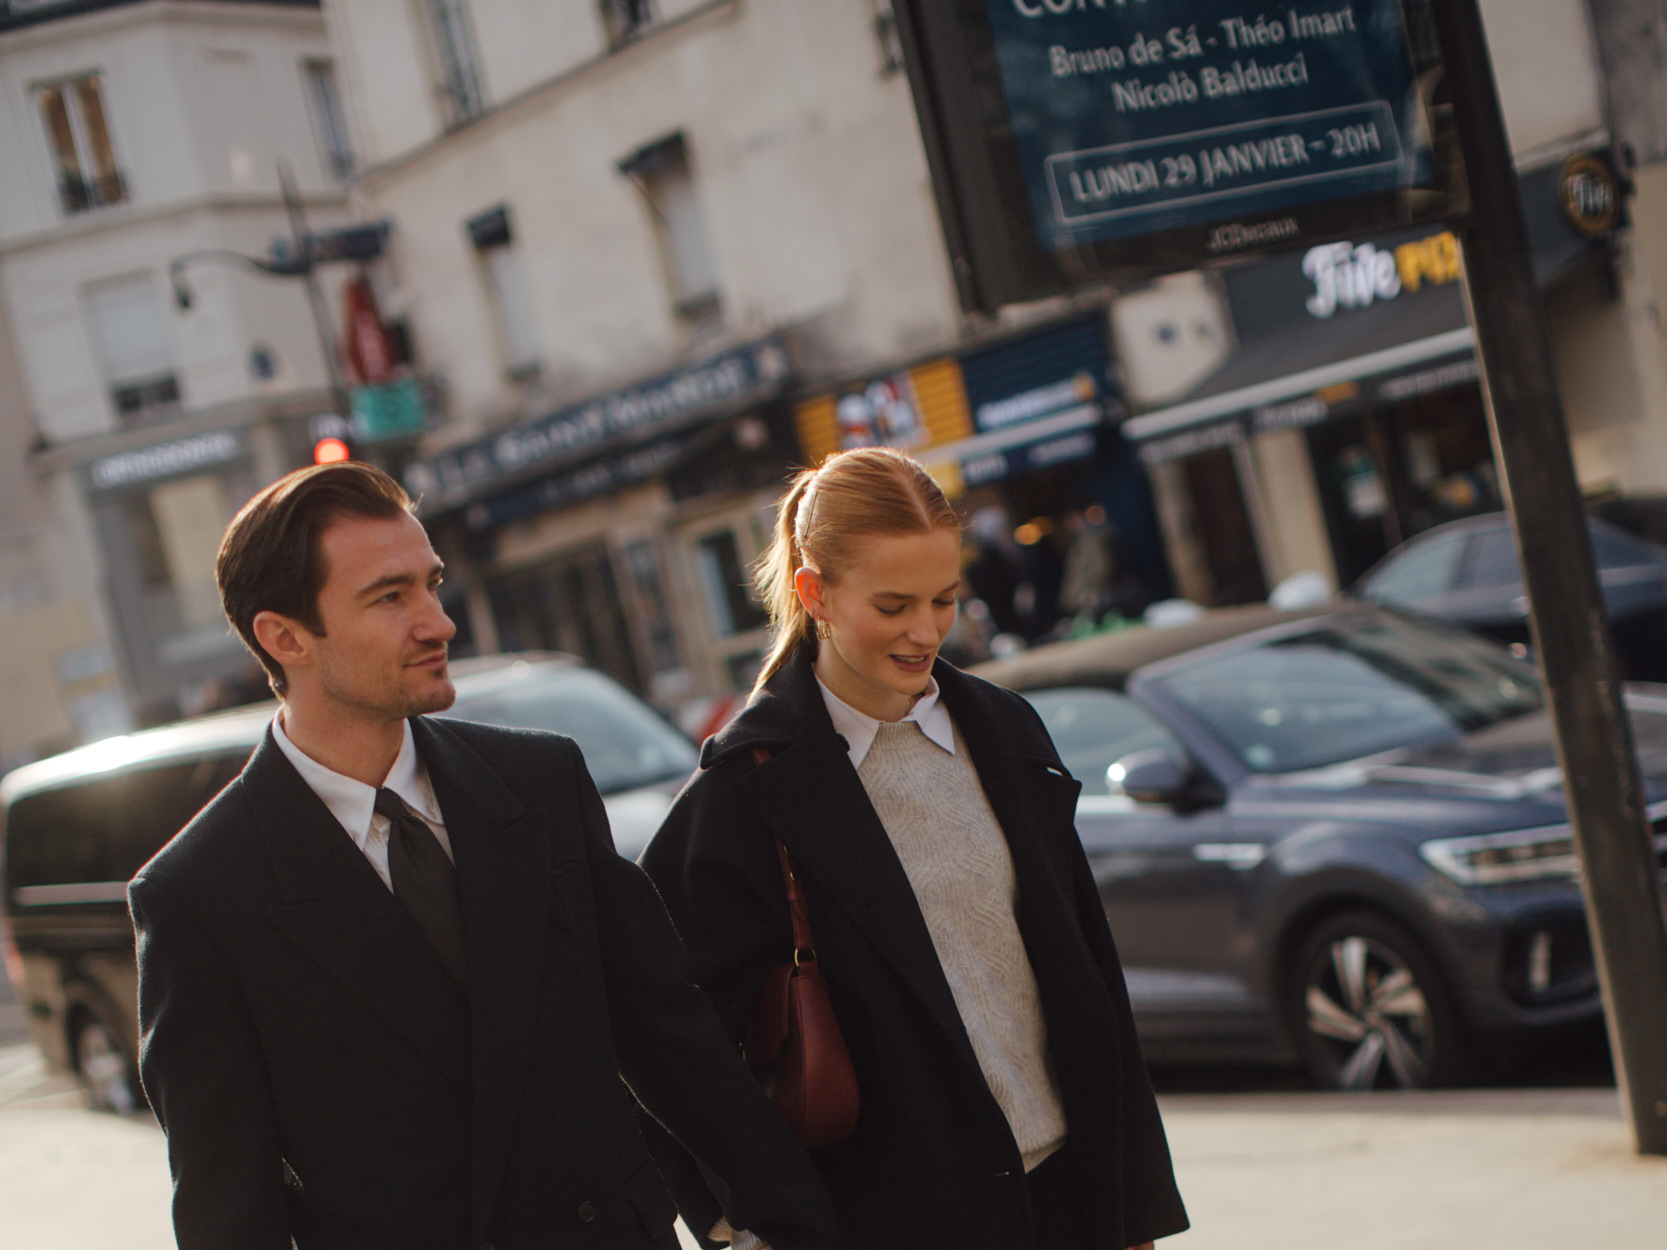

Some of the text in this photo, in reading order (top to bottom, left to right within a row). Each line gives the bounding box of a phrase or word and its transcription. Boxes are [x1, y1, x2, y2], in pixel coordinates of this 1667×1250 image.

[1050, 45, 1125, 77] Bruno
[1129, 32, 1164, 66] de
[1166, 24, 1203, 60] Sá
[1219, 14, 1285, 49] Théo
[1289, 5, 1357, 39] Imart
[1111, 51, 1310, 113] Nicolò Balducci
[1069, 160, 1160, 200] LUNDI
[1162, 153, 1197, 187] 29
[1200, 133, 1311, 187] JANVIER
[1326, 122, 1381, 158] 20H
